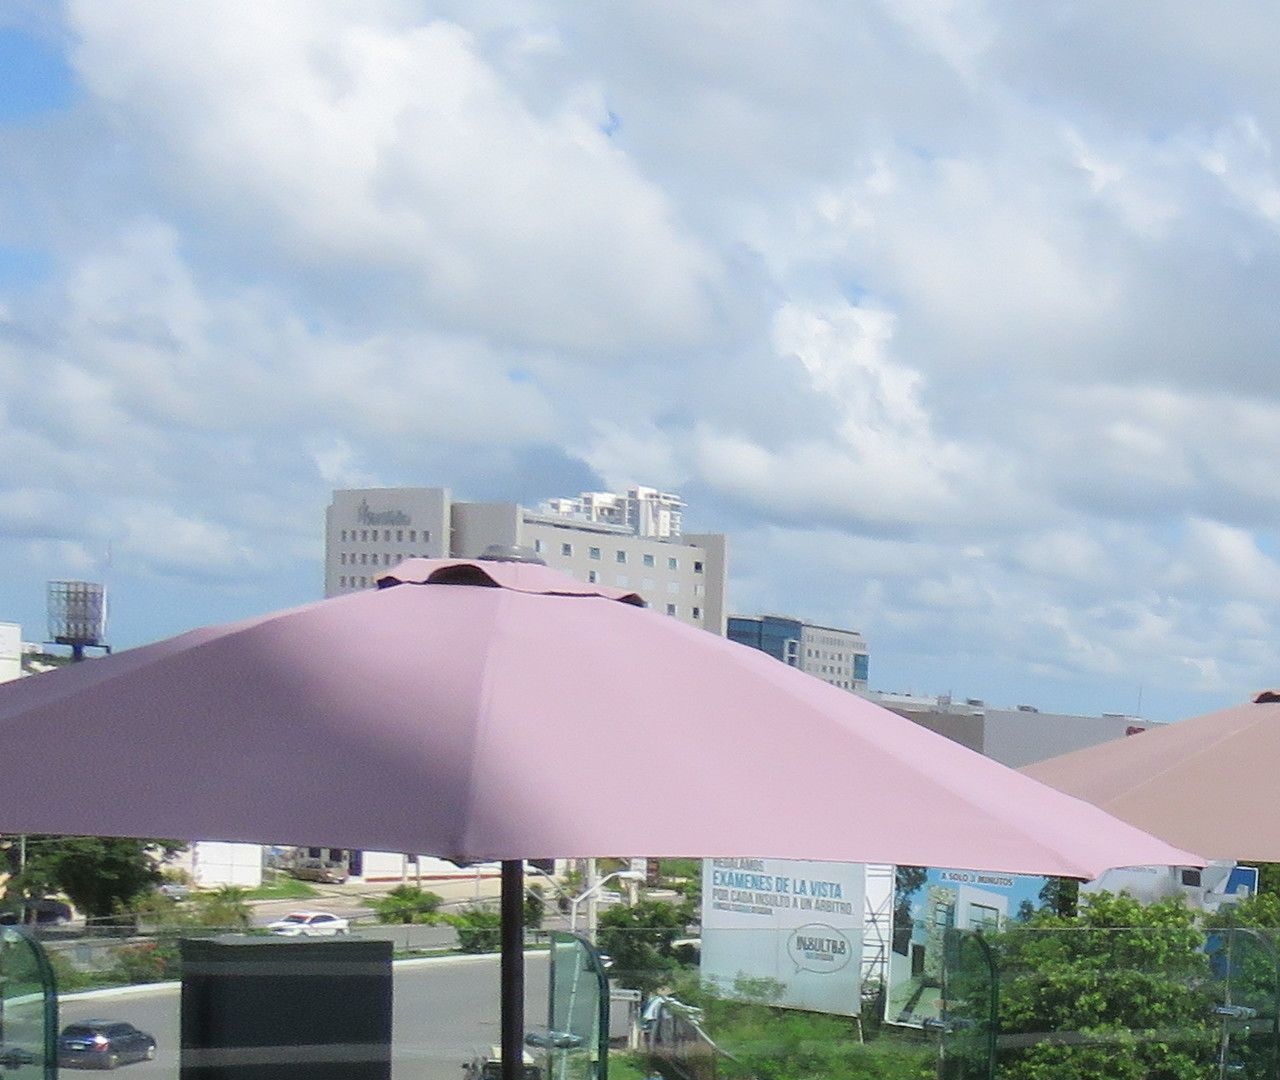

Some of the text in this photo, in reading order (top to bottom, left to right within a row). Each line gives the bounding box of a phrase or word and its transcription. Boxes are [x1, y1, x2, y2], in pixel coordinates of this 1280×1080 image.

[713, 871, 842, 899] EXAMENES DE LA VISTA
[712, 888, 729, 902] POR
[731, 890, 754, 904] CADA
[800, 898, 812, 910] UN
